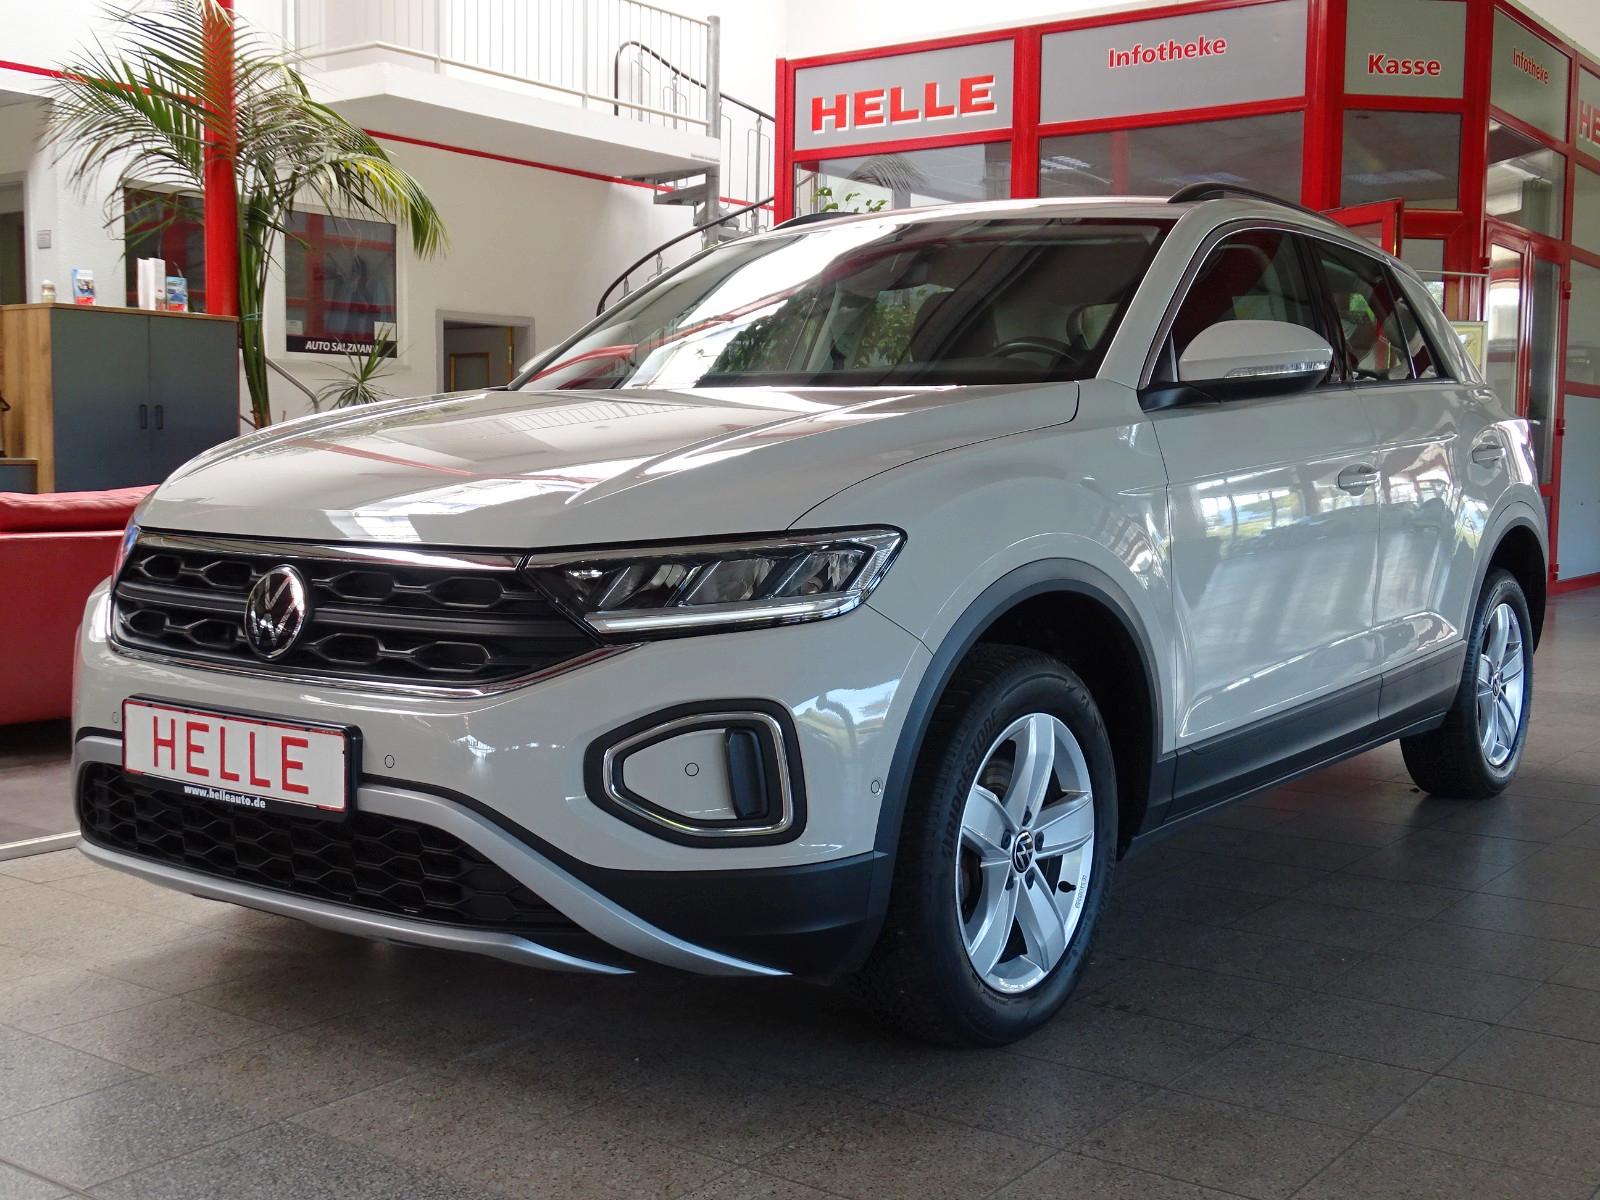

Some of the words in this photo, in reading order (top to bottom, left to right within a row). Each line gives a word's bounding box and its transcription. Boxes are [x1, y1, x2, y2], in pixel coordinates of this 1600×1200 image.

[1108, 35, 1227, 69] Infotheke
[1367, 53, 1441, 77] Kasse
[1512, 46, 1550, 87] Infotheke
[811, 74, 997, 135] HELLE
[305, 340, 331, 351] AUTO
[153, 715, 309, 795] HELLE
[184, 784, 266, 810] www.helleauto.de
